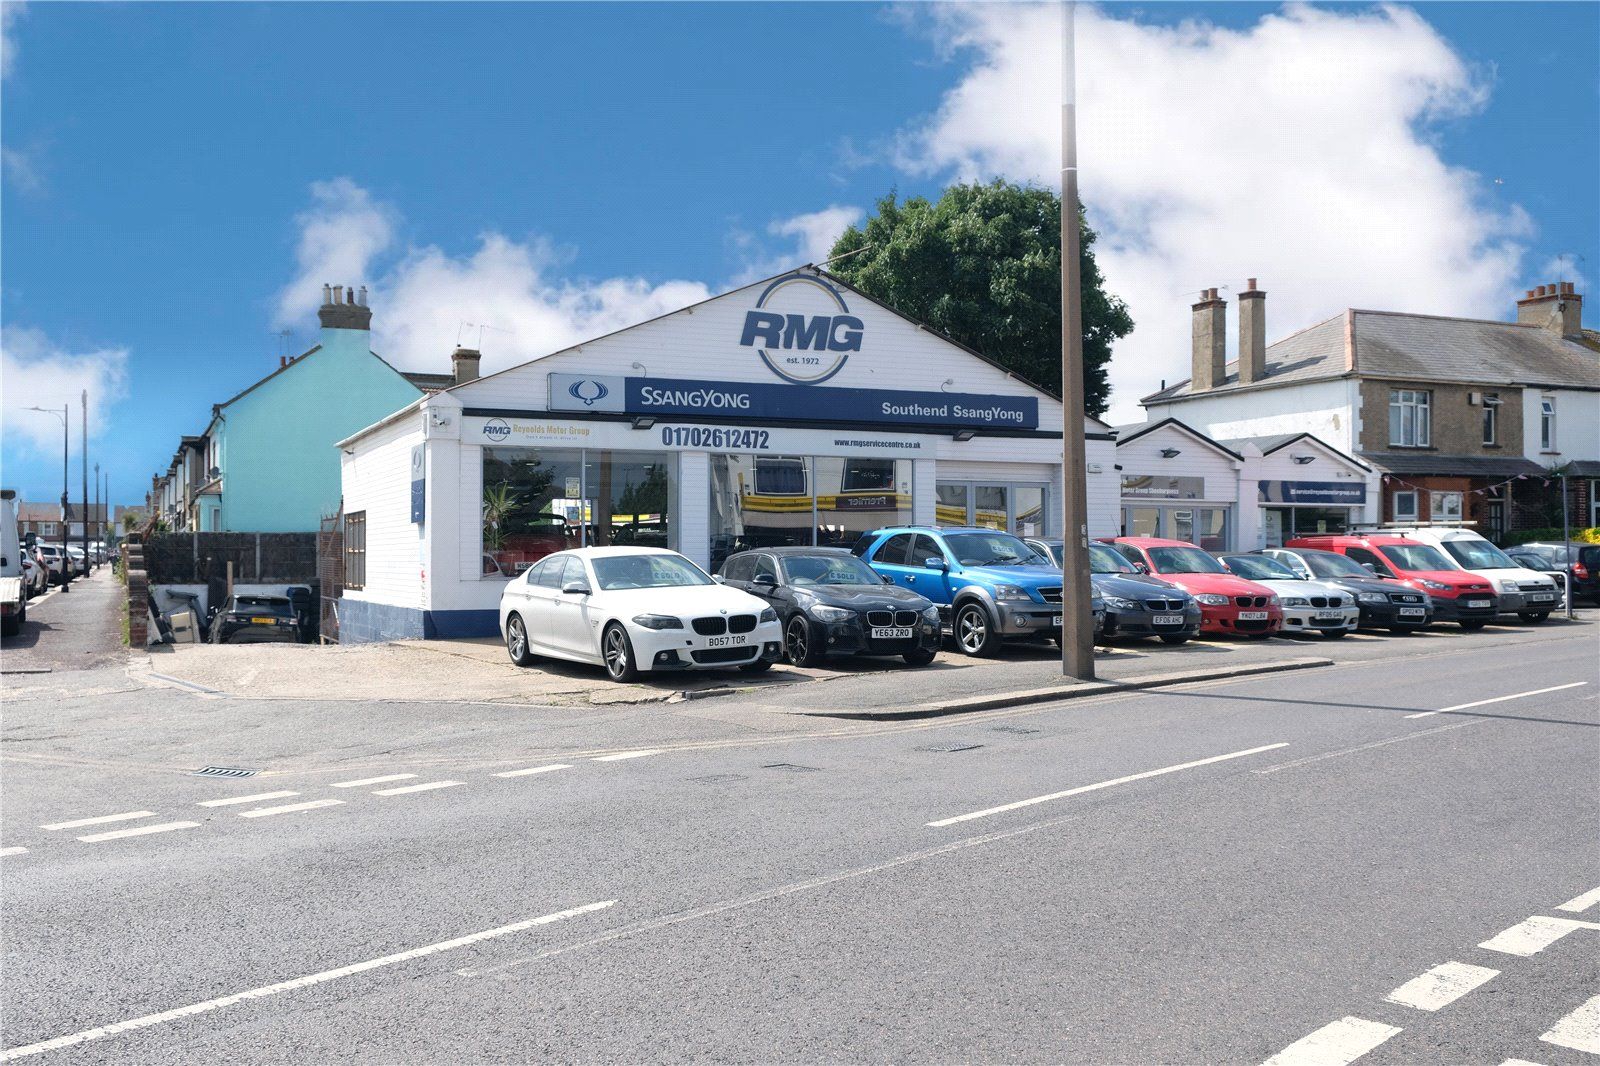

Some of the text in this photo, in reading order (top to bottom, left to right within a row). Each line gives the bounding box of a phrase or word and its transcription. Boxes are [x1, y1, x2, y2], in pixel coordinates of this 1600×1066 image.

[739, 311, 864, 351] RMG
[786, 355, 820, 365] est. 1972
[882, 402, 1024, 422] Southend SsangYong
[483, 426, 511, 435] RMG
[513, 424, 590, 436] Reynolds Motor Group
[662, 427, 769, 449] 01702612472
[834, 438, 921, 450] www.rmgservicecentre.co.uk
[837, 573, 856, 582] SOLD
[874, 628, 895, 638] YE63
[731, 634, 747, 645] TOR
